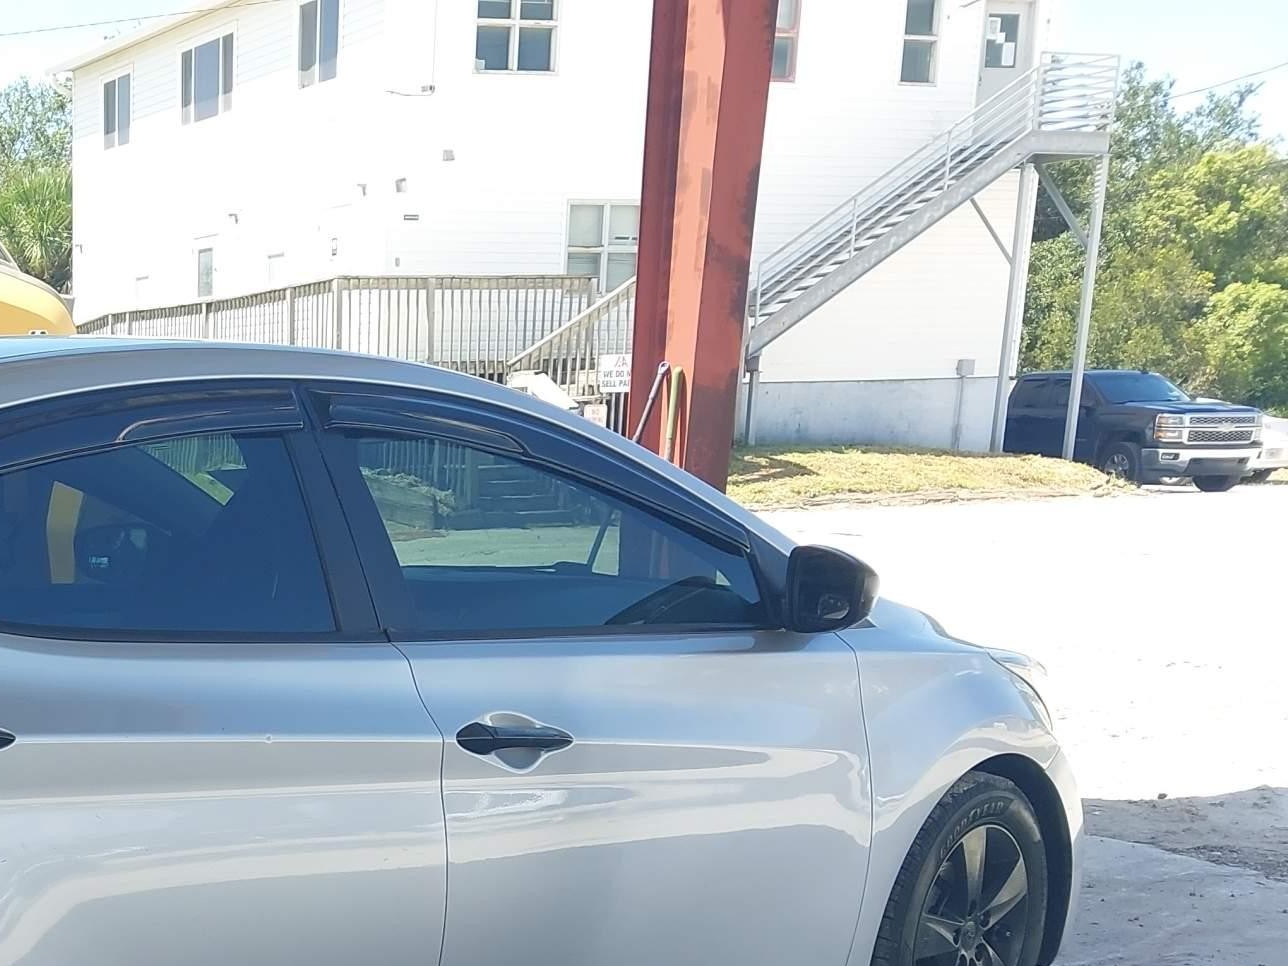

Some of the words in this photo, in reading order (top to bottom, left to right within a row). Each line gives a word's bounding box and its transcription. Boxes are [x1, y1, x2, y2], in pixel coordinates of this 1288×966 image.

[603, 370, 614, 378] WE
[615, 370, 625, 378] DO
[601, 380, 616, 388] SELL
